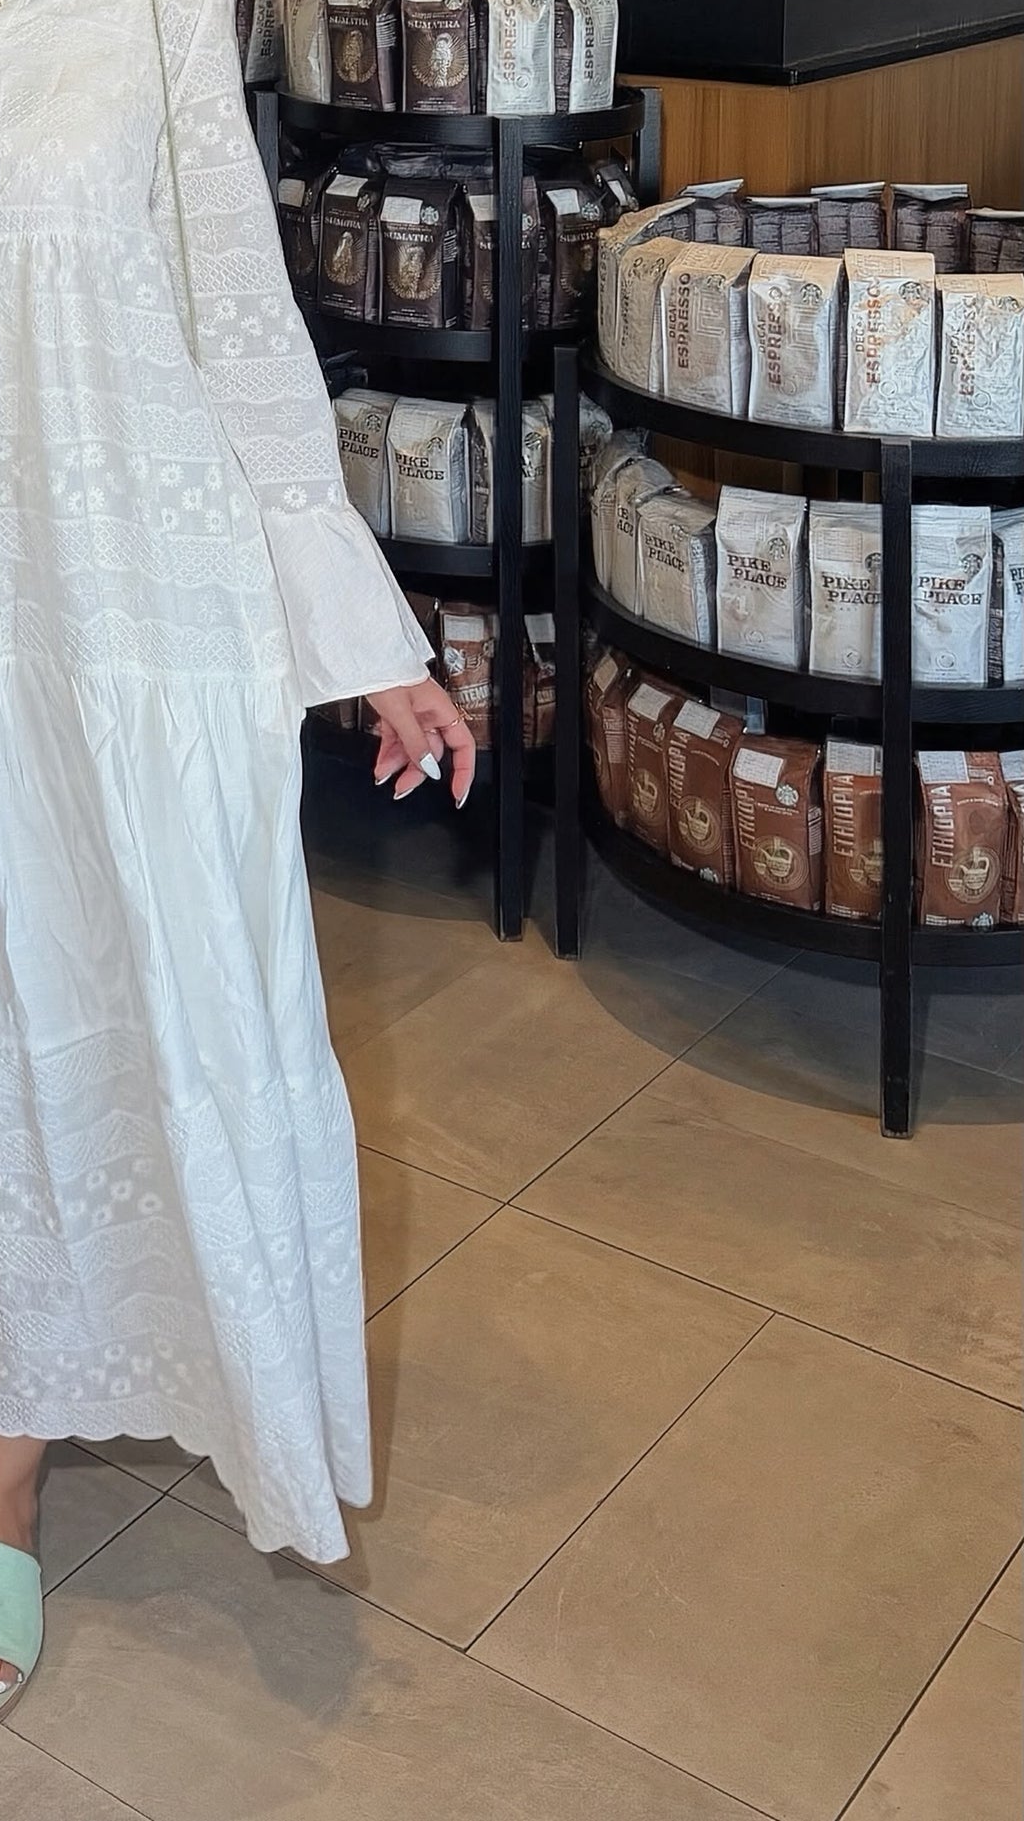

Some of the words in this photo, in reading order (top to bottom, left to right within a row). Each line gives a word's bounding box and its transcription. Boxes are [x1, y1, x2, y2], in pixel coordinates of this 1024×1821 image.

[407, 20, 461, 30] SUMATRA
[383, 232, 434, 243] SUMATRA
[669, 303, 677, 338] DECAF
[678, 272, 691, 370] ESPRESSO
[758, 317, 767, 354] DECAF
[768, 286, 783, 386] ESPRESSO
[339, 428, 369, 445] PIKE
[341, 441, 380, 459] PLACE
[395, 452, 430, 468] PIKE
[398, 465, 445, 481] PLACE
[644, 532, 676, 554] PIKE
[648, 546, 685, 573] PLACE
[726, 554, 771, 573] PIKE
[732, 567, 788, 590] PLACE
[822, 574, 871, 591] PIKE
[918, 576, 966, 591] PIKE
[827, 590, 881, 606] PLAC
[922, 590, 984, 605] PLACE
[669, 731, 691, 810] ETHIOPIA
[735, 782, 756, 851] ETHIOPI
[832, 774, 855, 858] ETHIOPIA
[931, 783, 955, 869] ETHIOPIA
